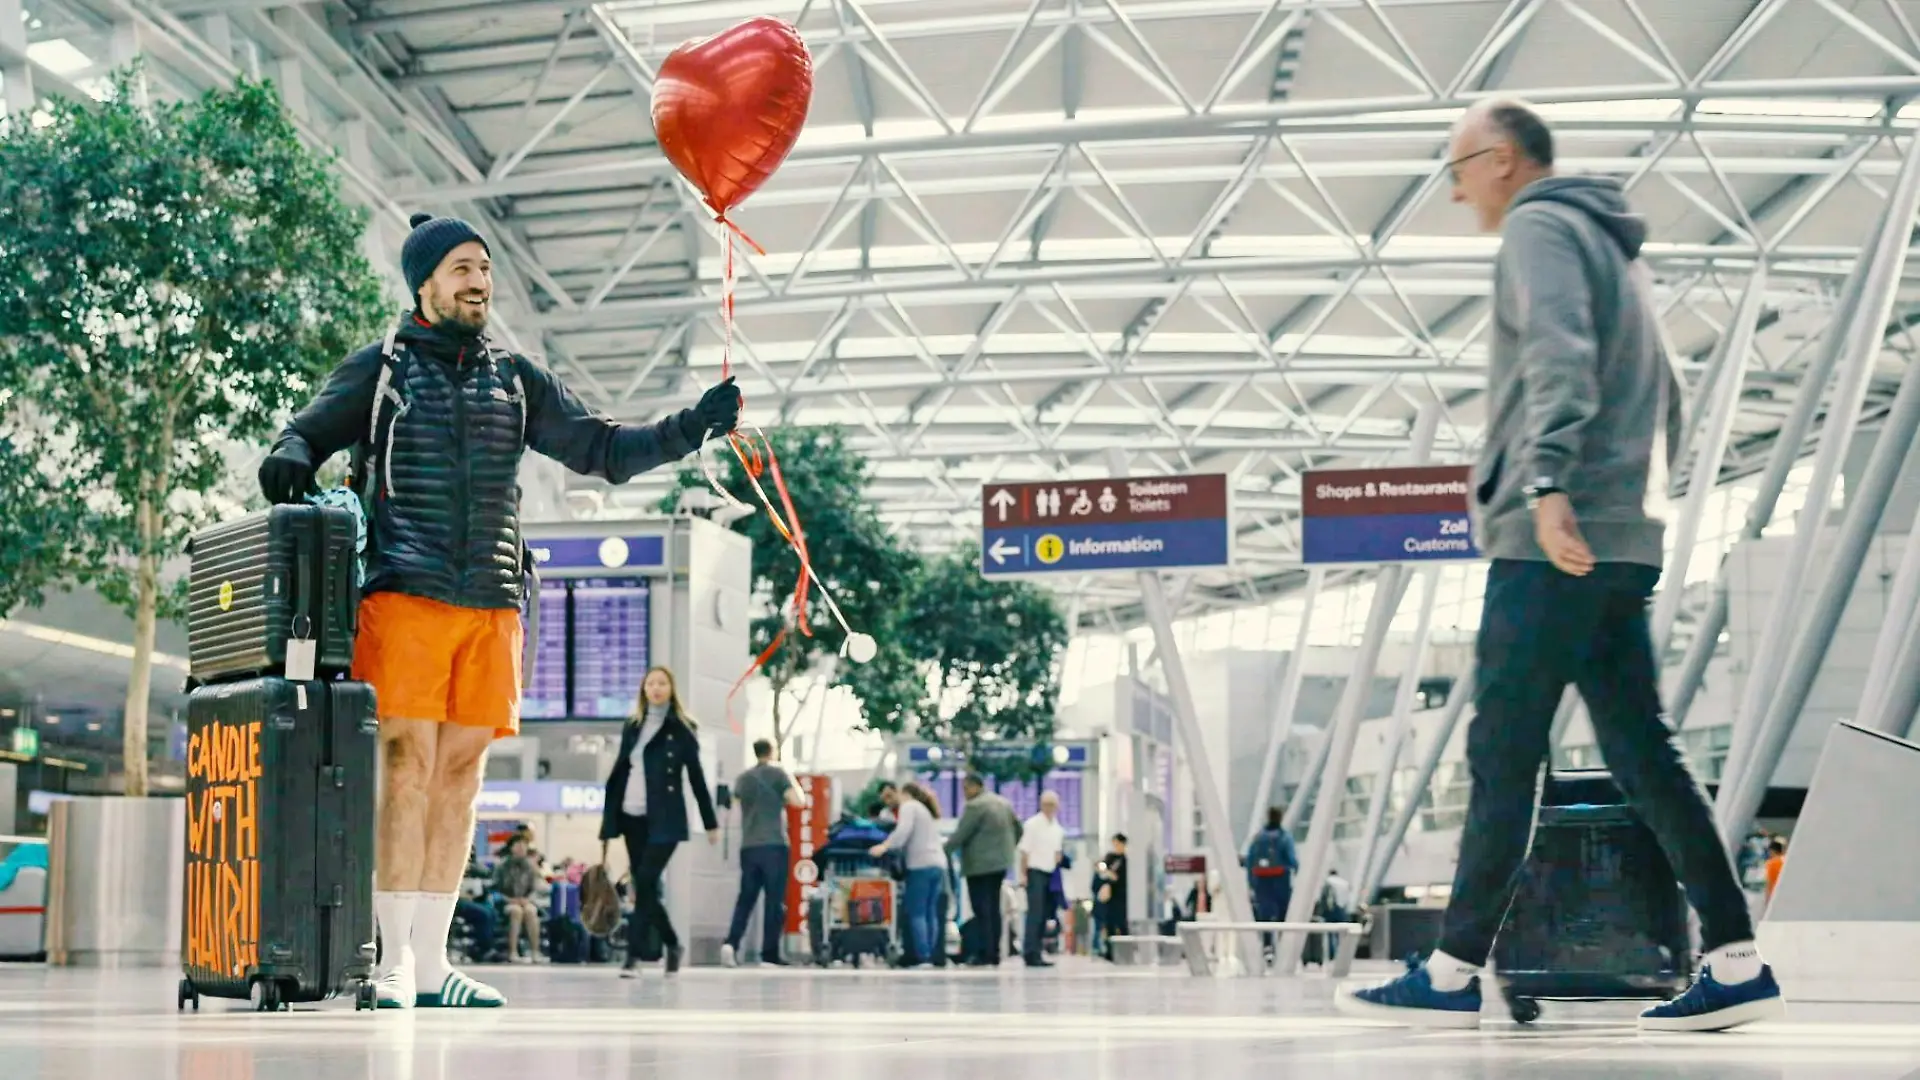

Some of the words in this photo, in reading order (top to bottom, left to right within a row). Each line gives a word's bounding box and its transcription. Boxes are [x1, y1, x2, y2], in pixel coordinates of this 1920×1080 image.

[1127, 481, 1188, 497] Toiletten
[1316, 483, 1362, 501] Shops
[1365, 482, 1377, 497] &
[1379, 480, 1468, 497] Restaurants
[1128, 498, 1171, 512] Toilets
[1439, 519, 1468, 534] Zoll
[1069, 535, 1164, 556] Information
[1403, 537, 1469, 552] Customs
[187, 720, 262, 783] CANDLE
[187, 779, 258, 862] WITH
[187, 858, 259, 978] HAIR!!
